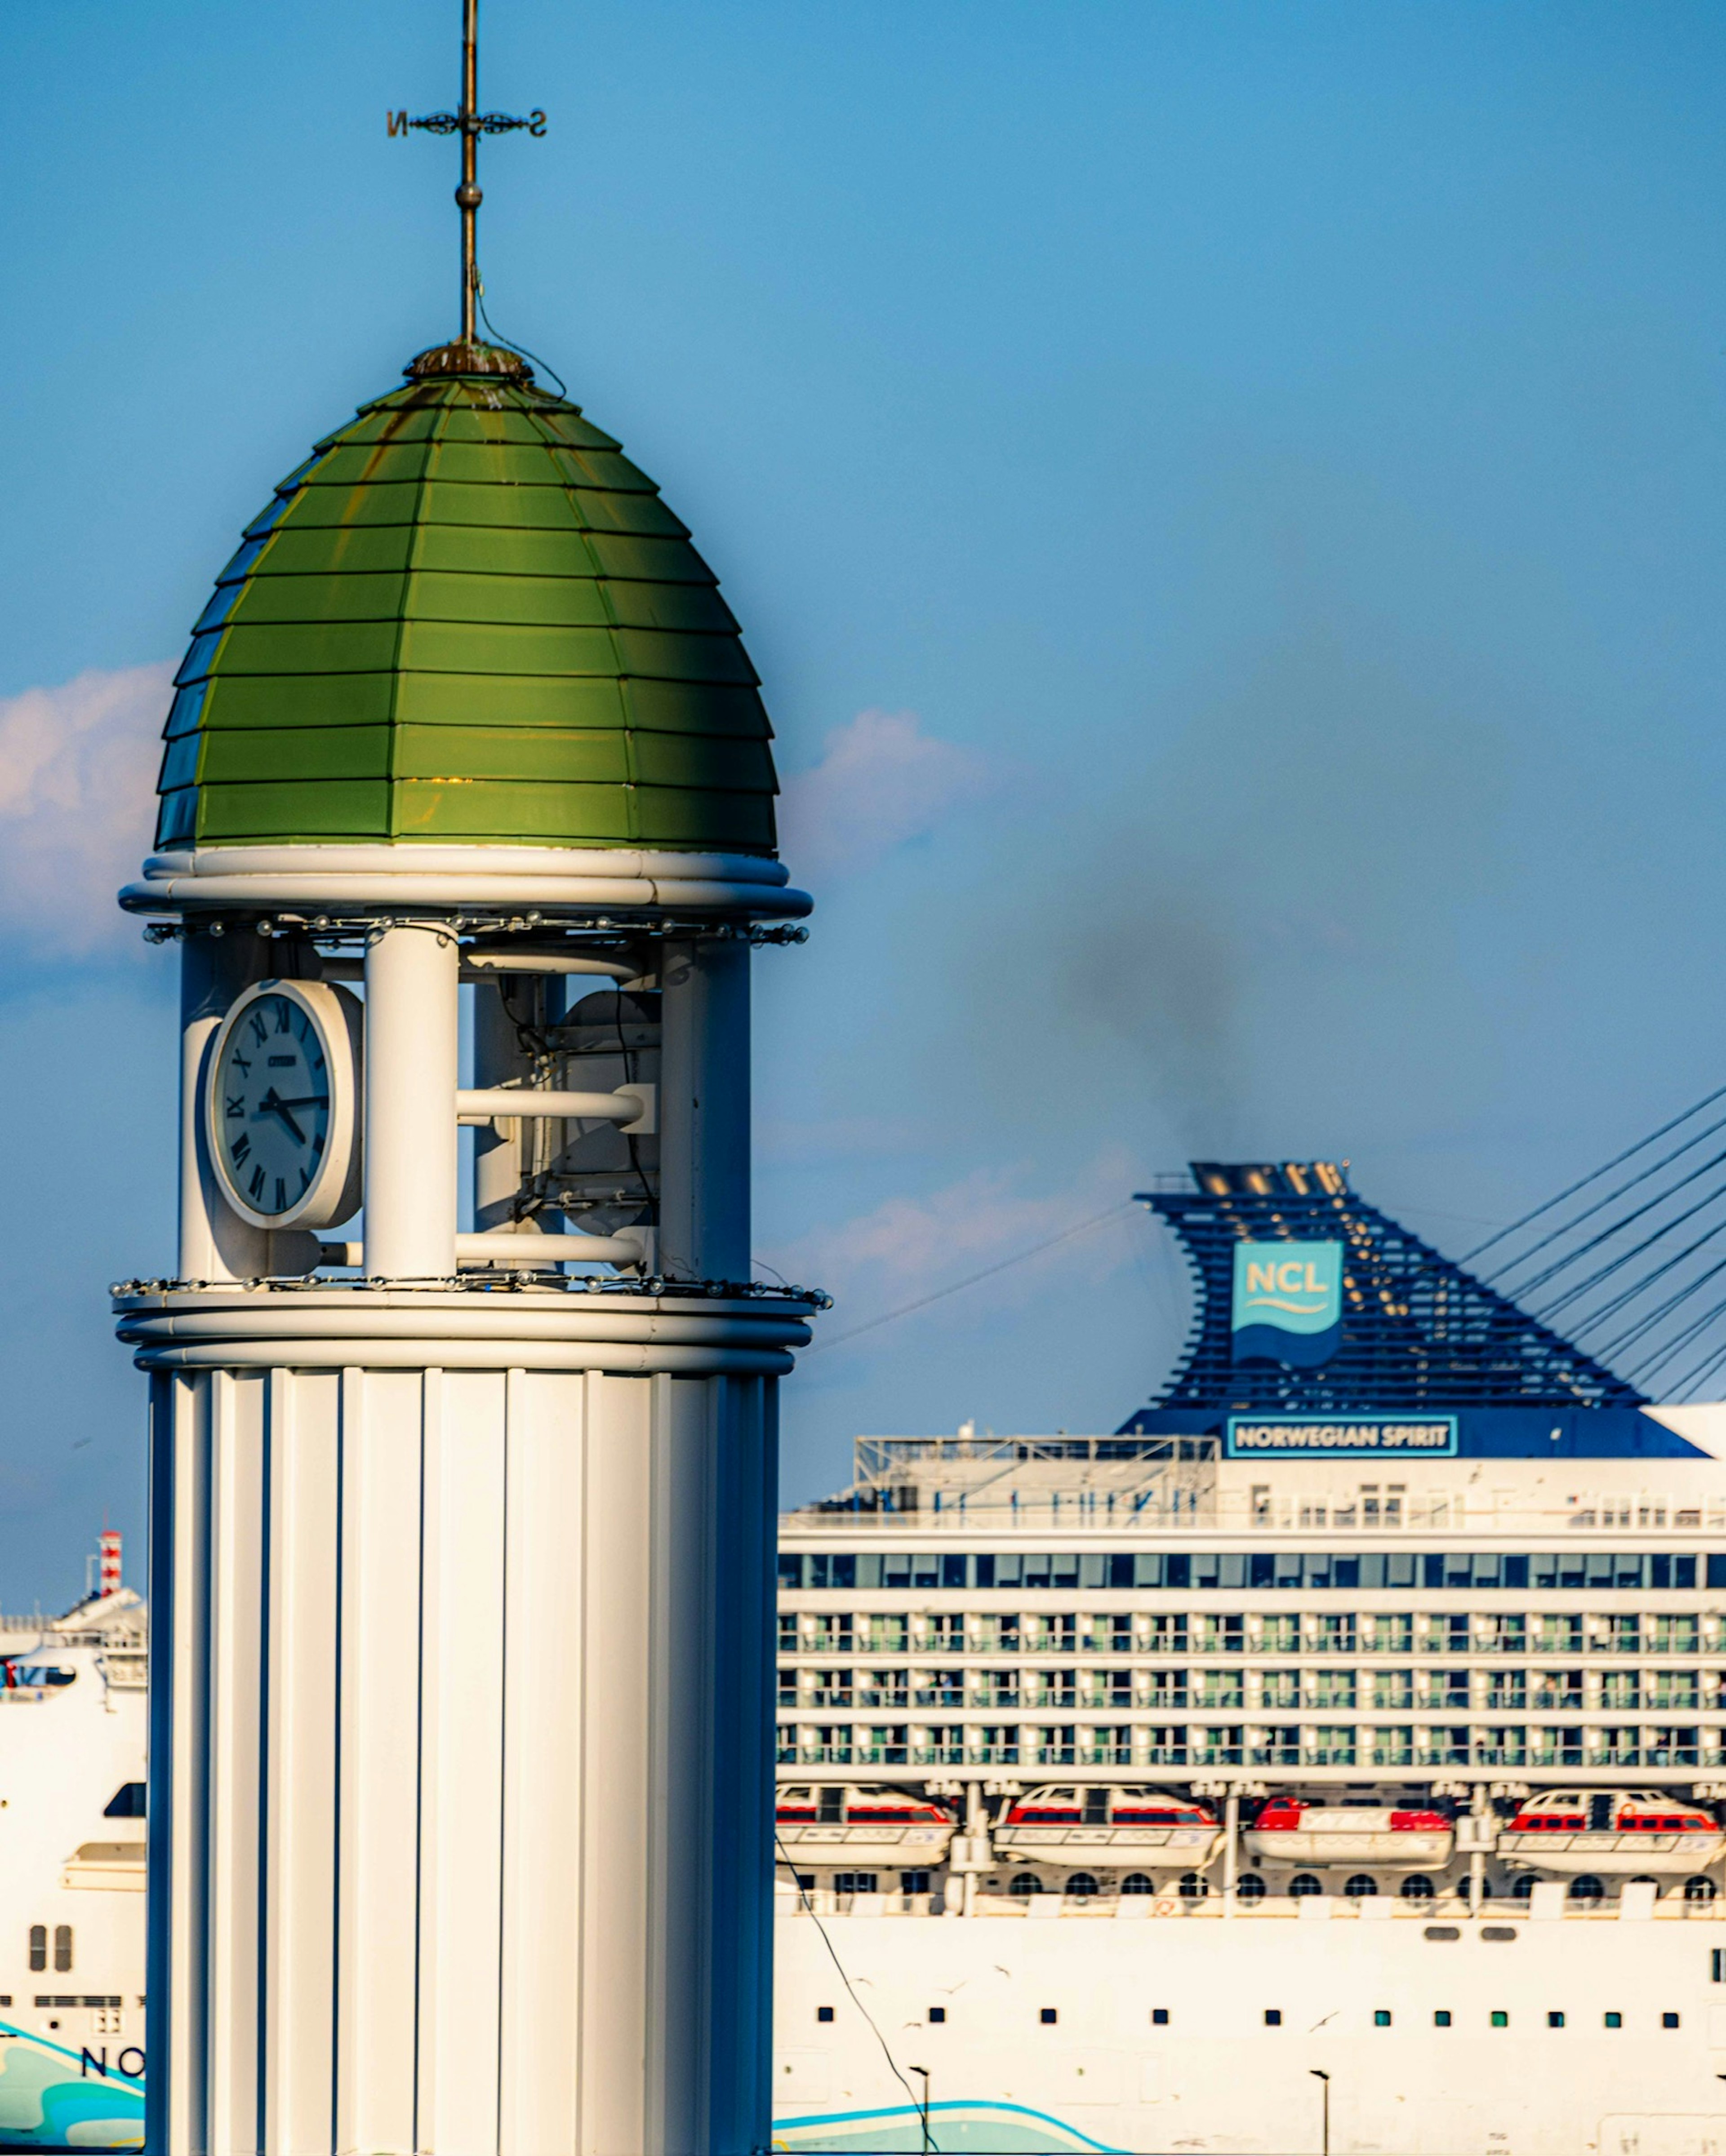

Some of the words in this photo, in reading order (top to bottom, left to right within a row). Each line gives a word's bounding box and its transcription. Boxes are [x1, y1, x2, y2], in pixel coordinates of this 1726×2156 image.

[1247, 1263, 1327, 1293] NCL
[1236, 1426, 1379, 1447] NORWEGIAN
[1381, 1425, 1449, 1446] SPIRIT
[82, 2047, 145, 2078] NO
